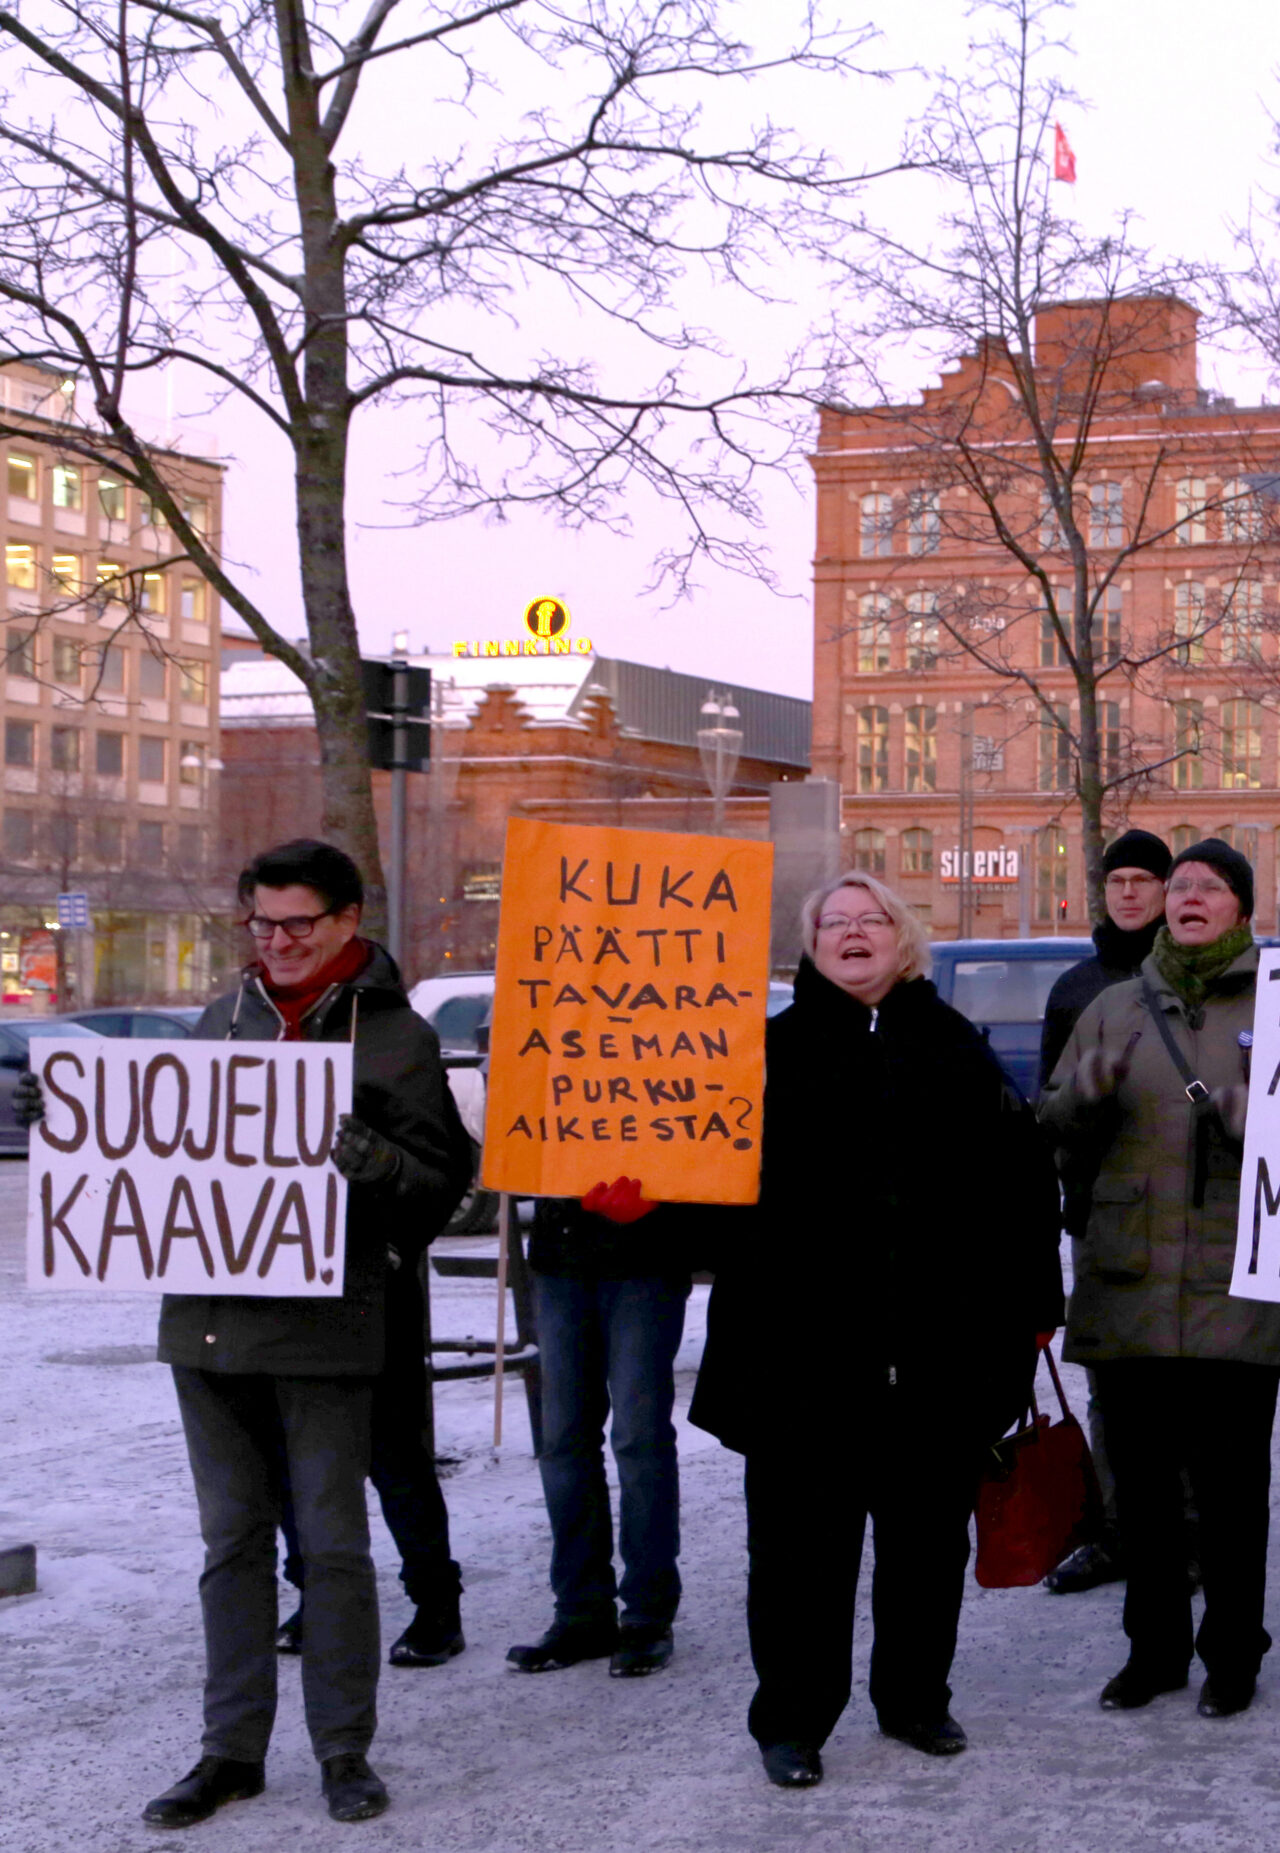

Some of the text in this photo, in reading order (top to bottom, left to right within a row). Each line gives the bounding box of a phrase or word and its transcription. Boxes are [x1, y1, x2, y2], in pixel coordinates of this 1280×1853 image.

[452, 637, 592, 657] FINNKINO
[560, 856, 738, 912] KUKA
[533, 924, 726, 966] PÄÄTTI
[518, 979, 753, 1010] TAVARA-
[518, 1028, 729, 1060] ASEMAN
[40, 1051, 336, 1168] SUOJELU
[552, 1074, 724, 1106] PURKU-
[507, 1096, 753, 1151] AIKEESTA?
[39, 1168, 338, 1286] KAAVA!
